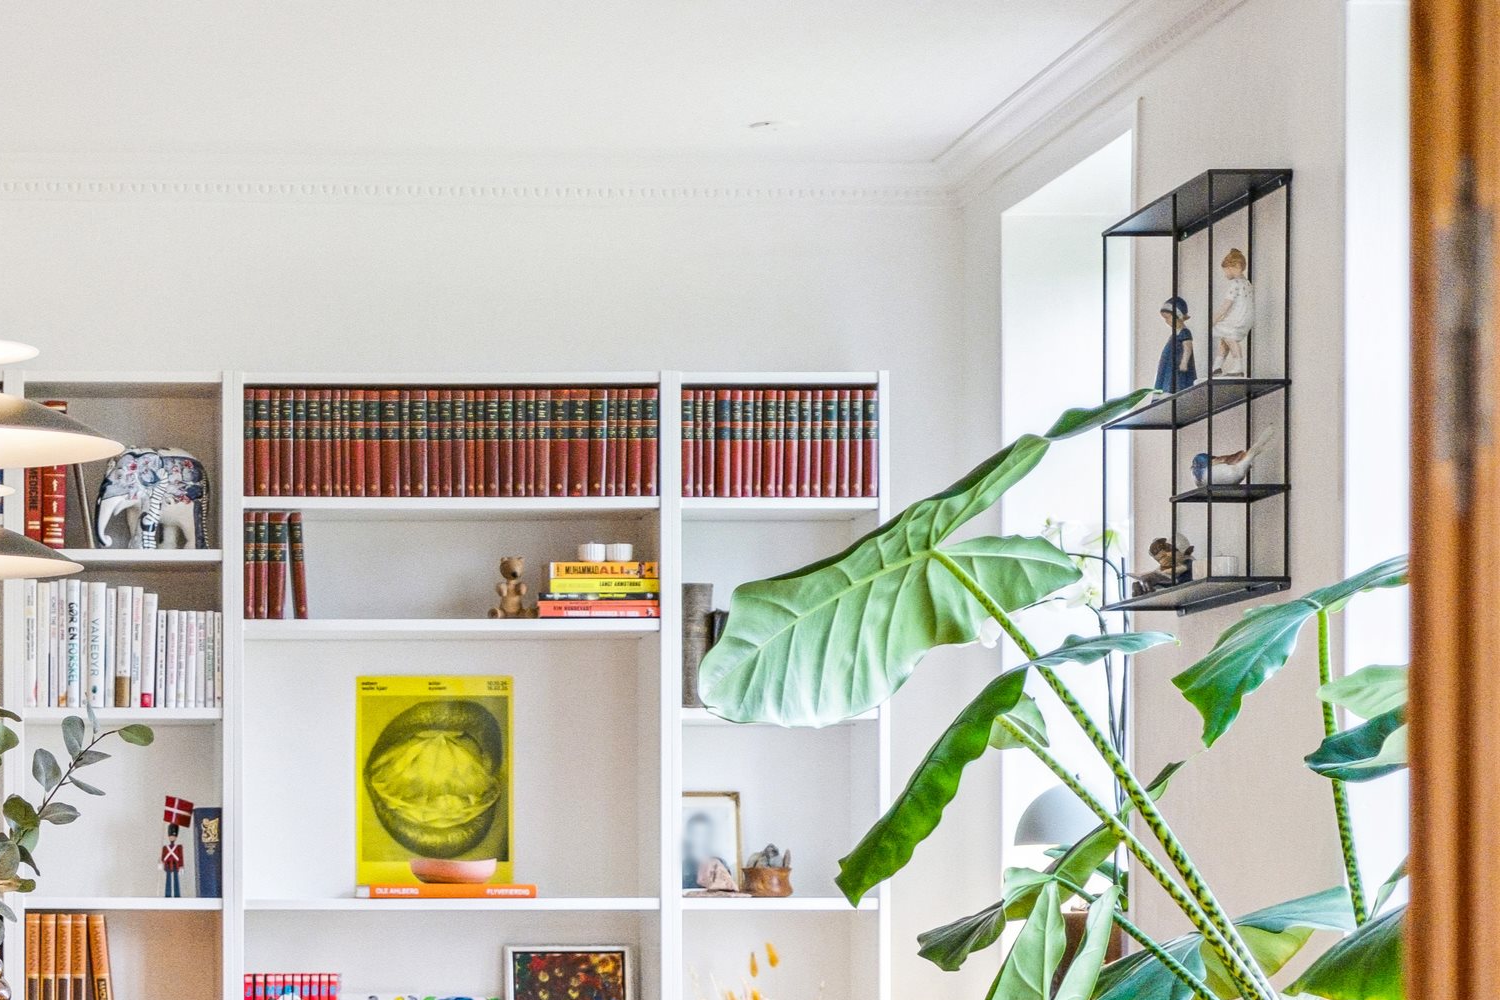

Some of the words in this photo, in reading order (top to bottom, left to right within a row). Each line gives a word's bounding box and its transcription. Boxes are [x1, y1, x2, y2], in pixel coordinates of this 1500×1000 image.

[565, 566, 599, 574] MUHAMMAD
[599, 566, 624, 574] ALI
[68, 602, 78, 623] GØR
[69, 626, 77, 640] EN
[91, 618, 99, 677] VANEDYR
[68, 643, 77, 686] FORSKEL
[389, 888, 419, 896] AHLBERG
